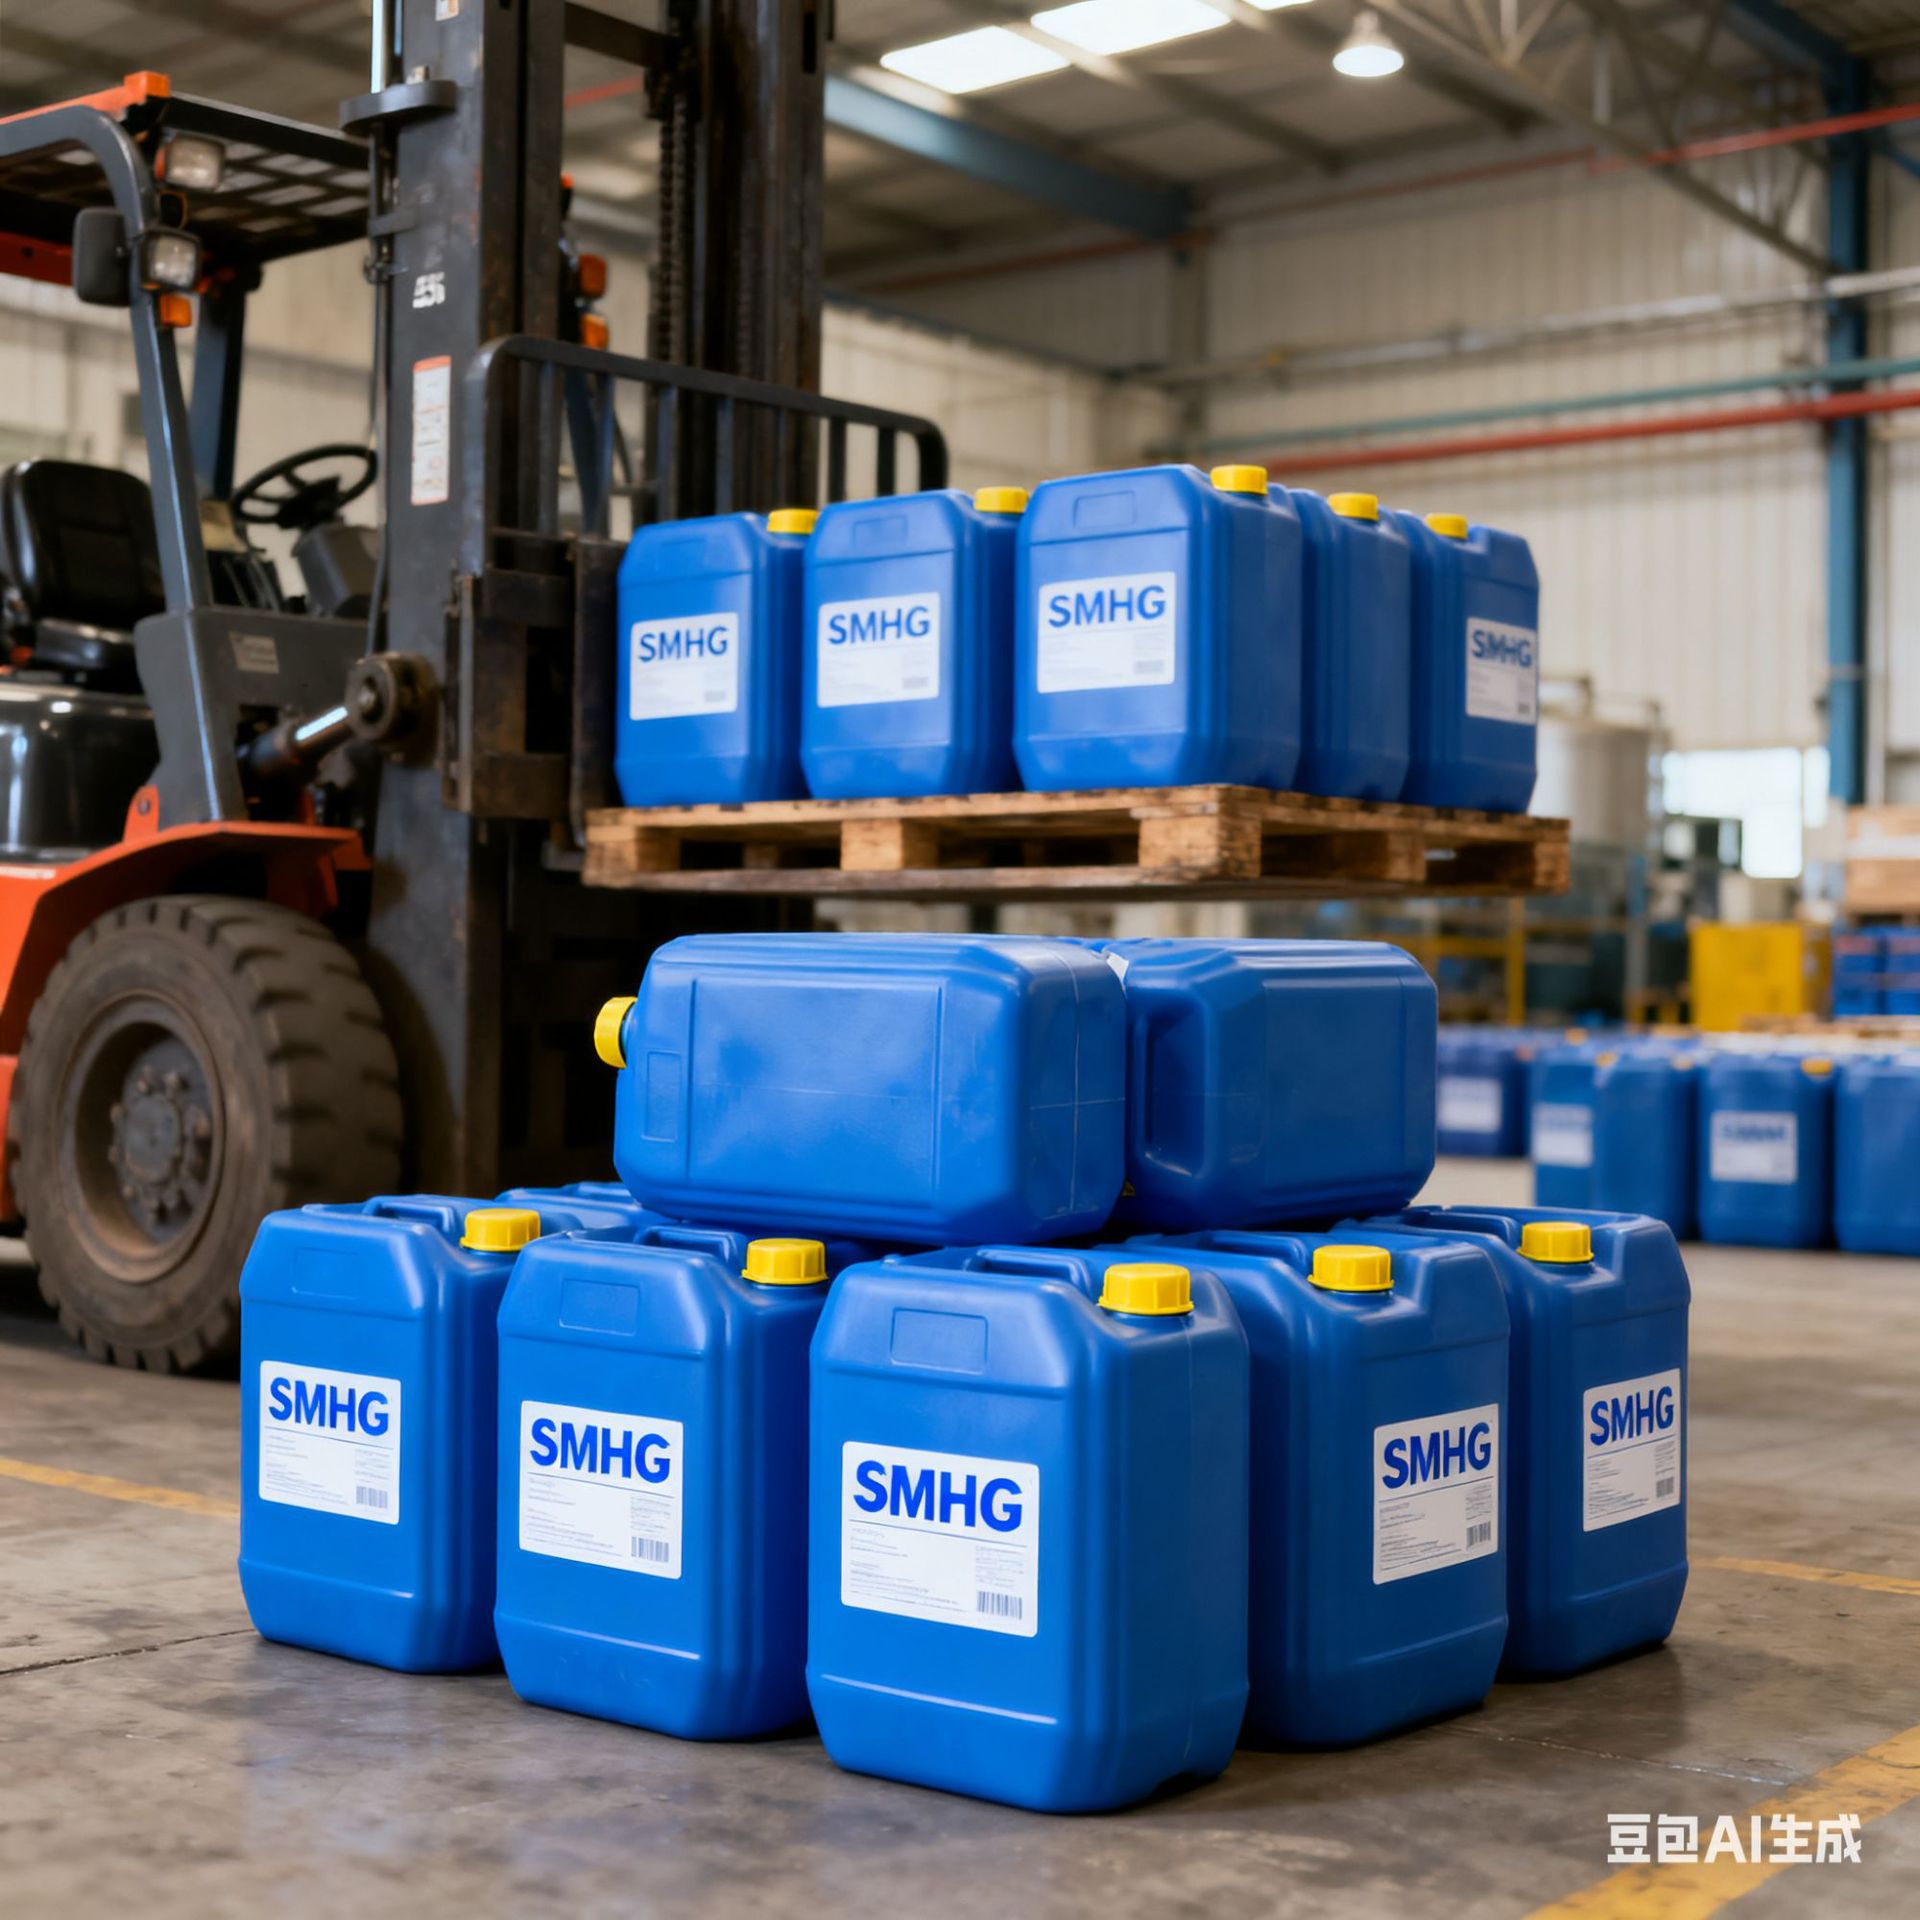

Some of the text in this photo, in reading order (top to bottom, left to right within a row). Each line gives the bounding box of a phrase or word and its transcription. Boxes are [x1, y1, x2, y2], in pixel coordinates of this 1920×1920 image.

[826, 604, 931, 645] SMHG
[1048, 584, 1166, 627] SMHG
[638, 625, 729, 662] SMHG
[268, 1376, 389, 1436] SMHG
[1590, 1386, 1674, 1446] SMHG
[530, 1418, 671, 1484] SMHG
[1382, 1421, 1492, 1489] SMHG
[853, 1459, 1023, 1532] SMHG
